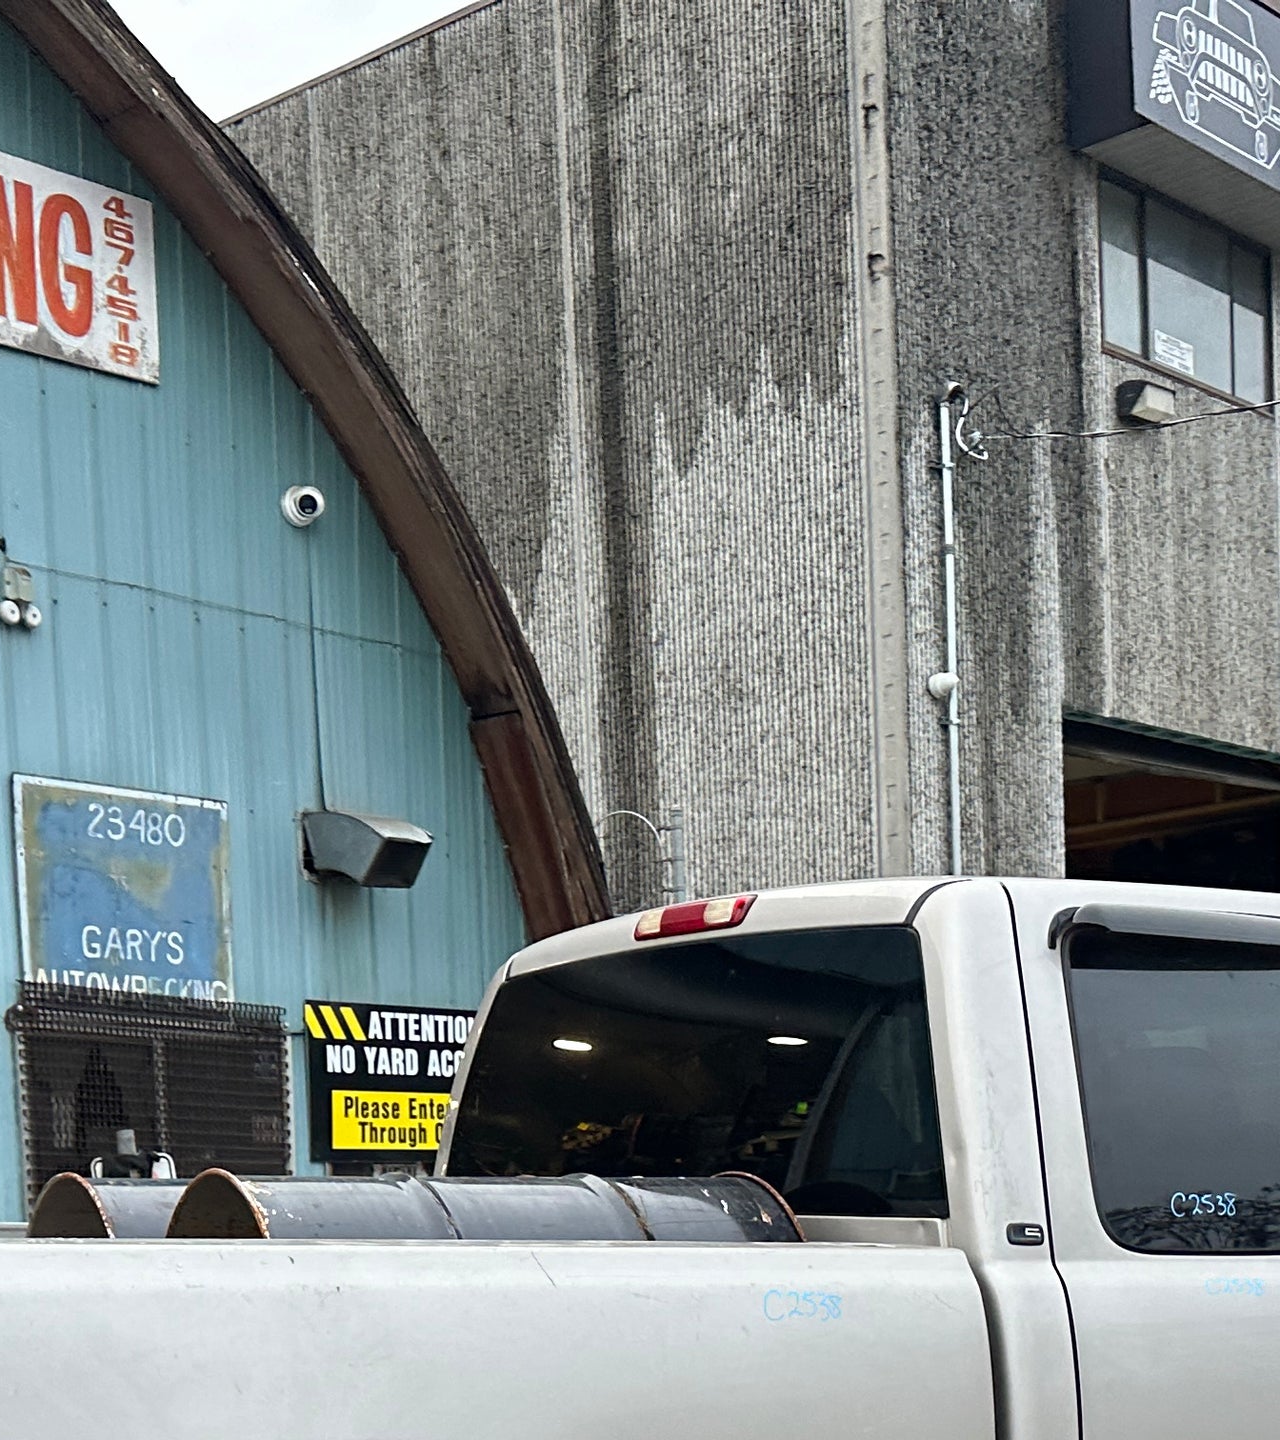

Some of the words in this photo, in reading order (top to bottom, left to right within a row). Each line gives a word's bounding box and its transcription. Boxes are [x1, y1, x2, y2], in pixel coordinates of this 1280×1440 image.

[87, 802, 186, 847] 23480
[81, 924, 184, 965] GARY'S
[325, 1045, 356, 1074] NO
[363, 1046, 419, 1076] YARD
[344, 1096, 400, 1119] Please
[358, 1121, 427, 1148] Through
[1171, 1191, 1238, 1218] C2538
